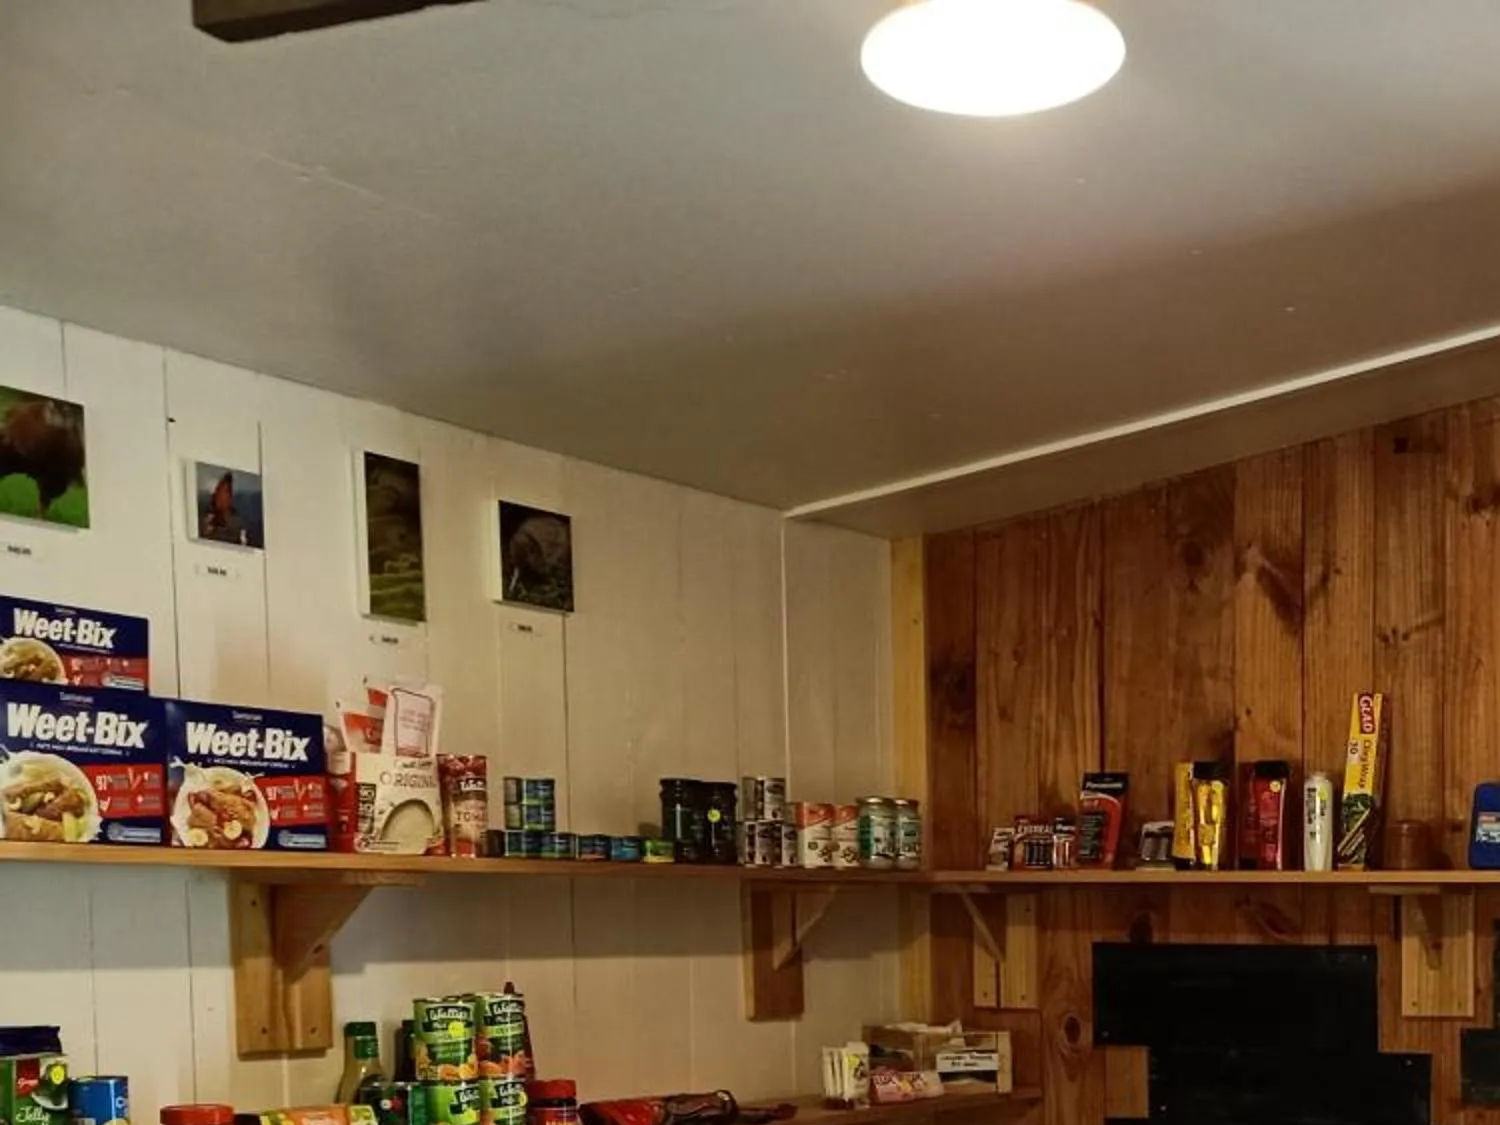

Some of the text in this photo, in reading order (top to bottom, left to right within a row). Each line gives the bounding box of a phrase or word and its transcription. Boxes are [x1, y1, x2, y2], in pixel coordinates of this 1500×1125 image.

[13, 607, 117, 649] Weet-Bix
[7, 702, 148, 748] Weet-Bix
[1360, 695, 1373, 733] GLAD
[186, 721, 311, 762] Weet-Bix
